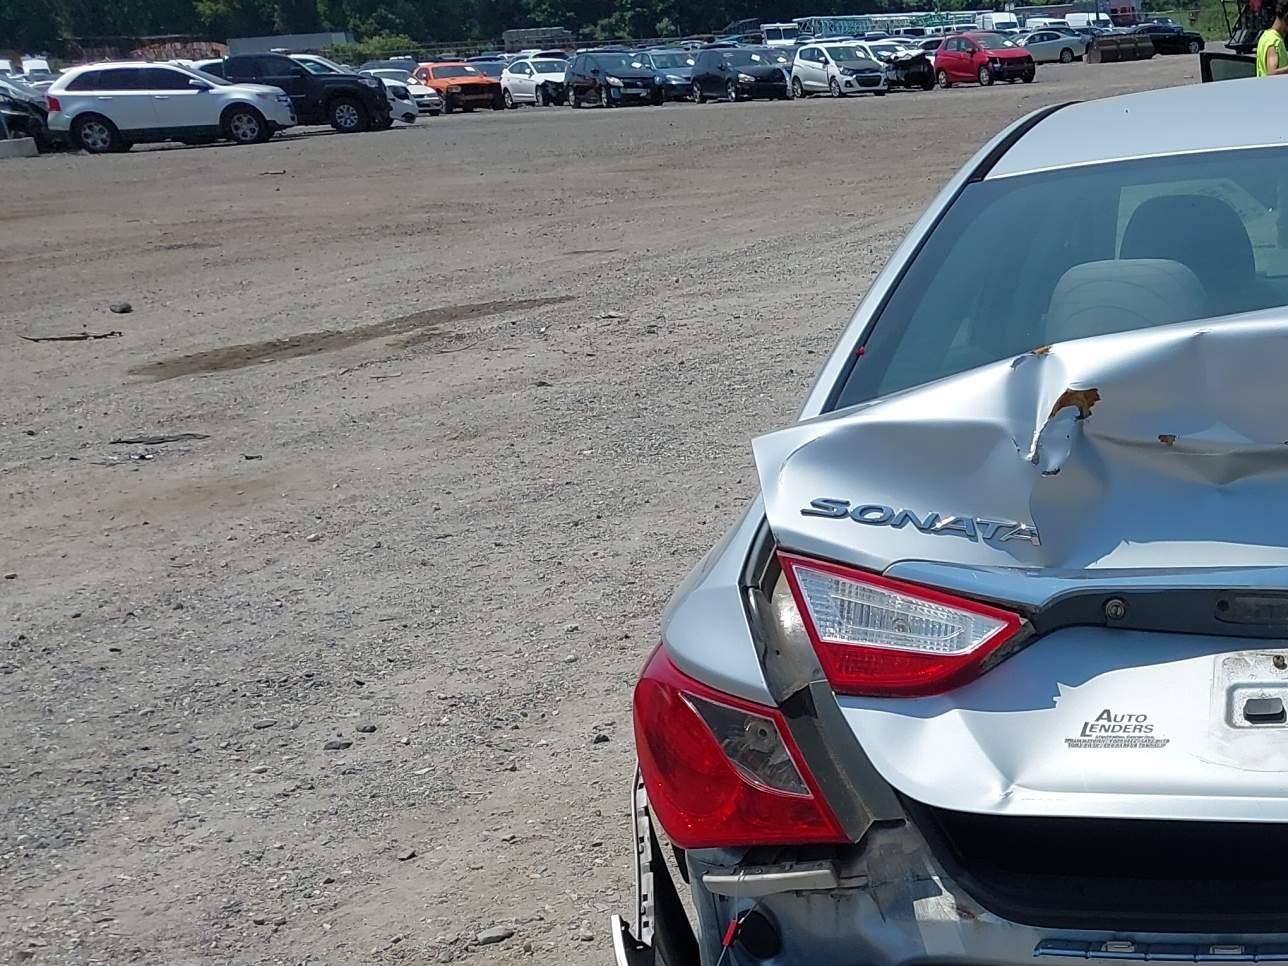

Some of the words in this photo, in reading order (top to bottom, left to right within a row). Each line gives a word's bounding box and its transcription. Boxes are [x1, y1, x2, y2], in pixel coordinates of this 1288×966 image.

[800, 497, 1042, 547] SONATA
[1095, 708, 1148, 723] AUTO
[1080, 721, 1155, 738] LENDERS
